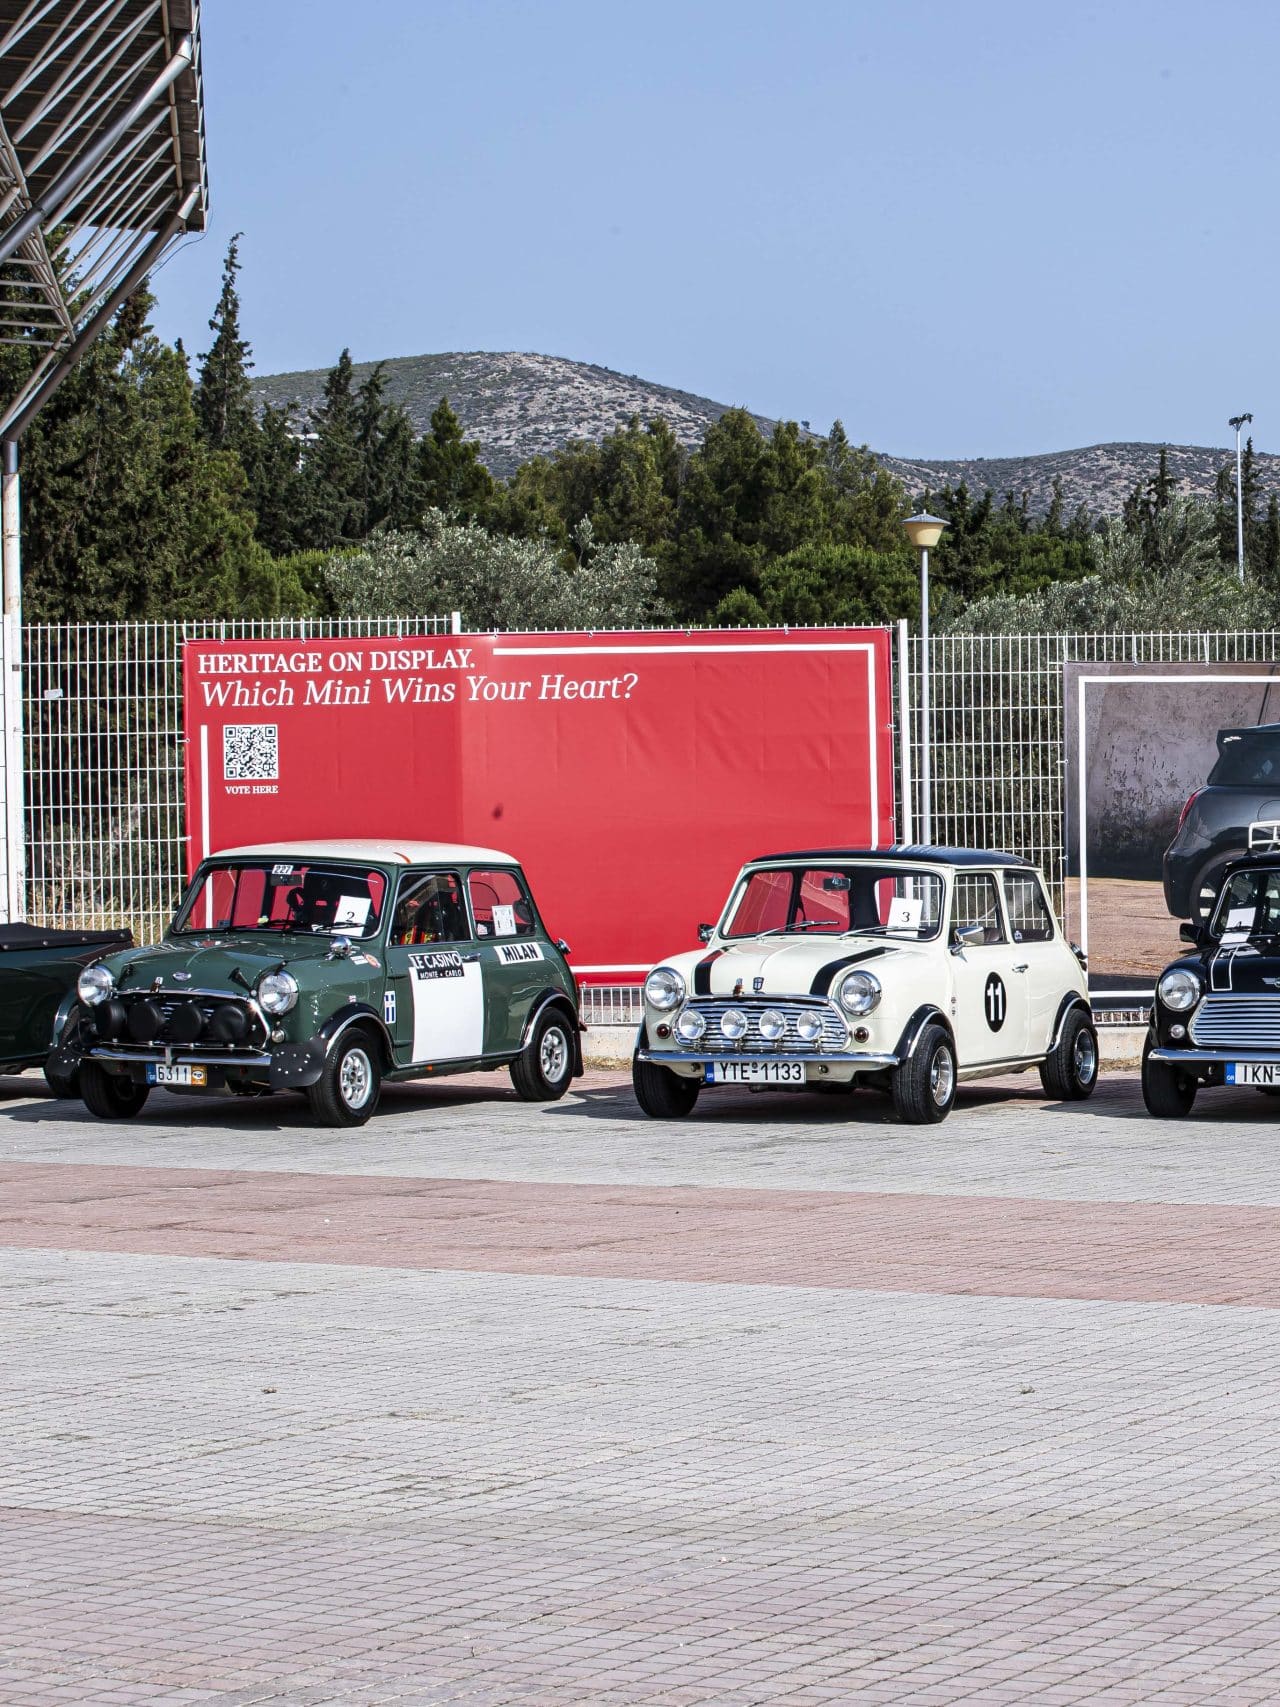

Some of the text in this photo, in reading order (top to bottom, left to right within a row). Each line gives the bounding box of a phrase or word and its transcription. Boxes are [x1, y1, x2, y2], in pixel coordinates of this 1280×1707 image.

[198, 649, 475, 674] HERITAGE ON DISPLAY.
[201, 673, 638, 706] Which Mini Wins Your Heart?
[225, 785, 279, 795] VOTE HERE
[346, 911, 355, 923] 2
[901, 911, 911, 923] 3
[501, 944, 540, 962] MILAN
[410, 953, 462, 969] LE CASINO
[420, 969, 462, 979] MONTE CARLO
[986, 982, 1003, 1022] 11
[158, 1066, 188, 1081] 6311
